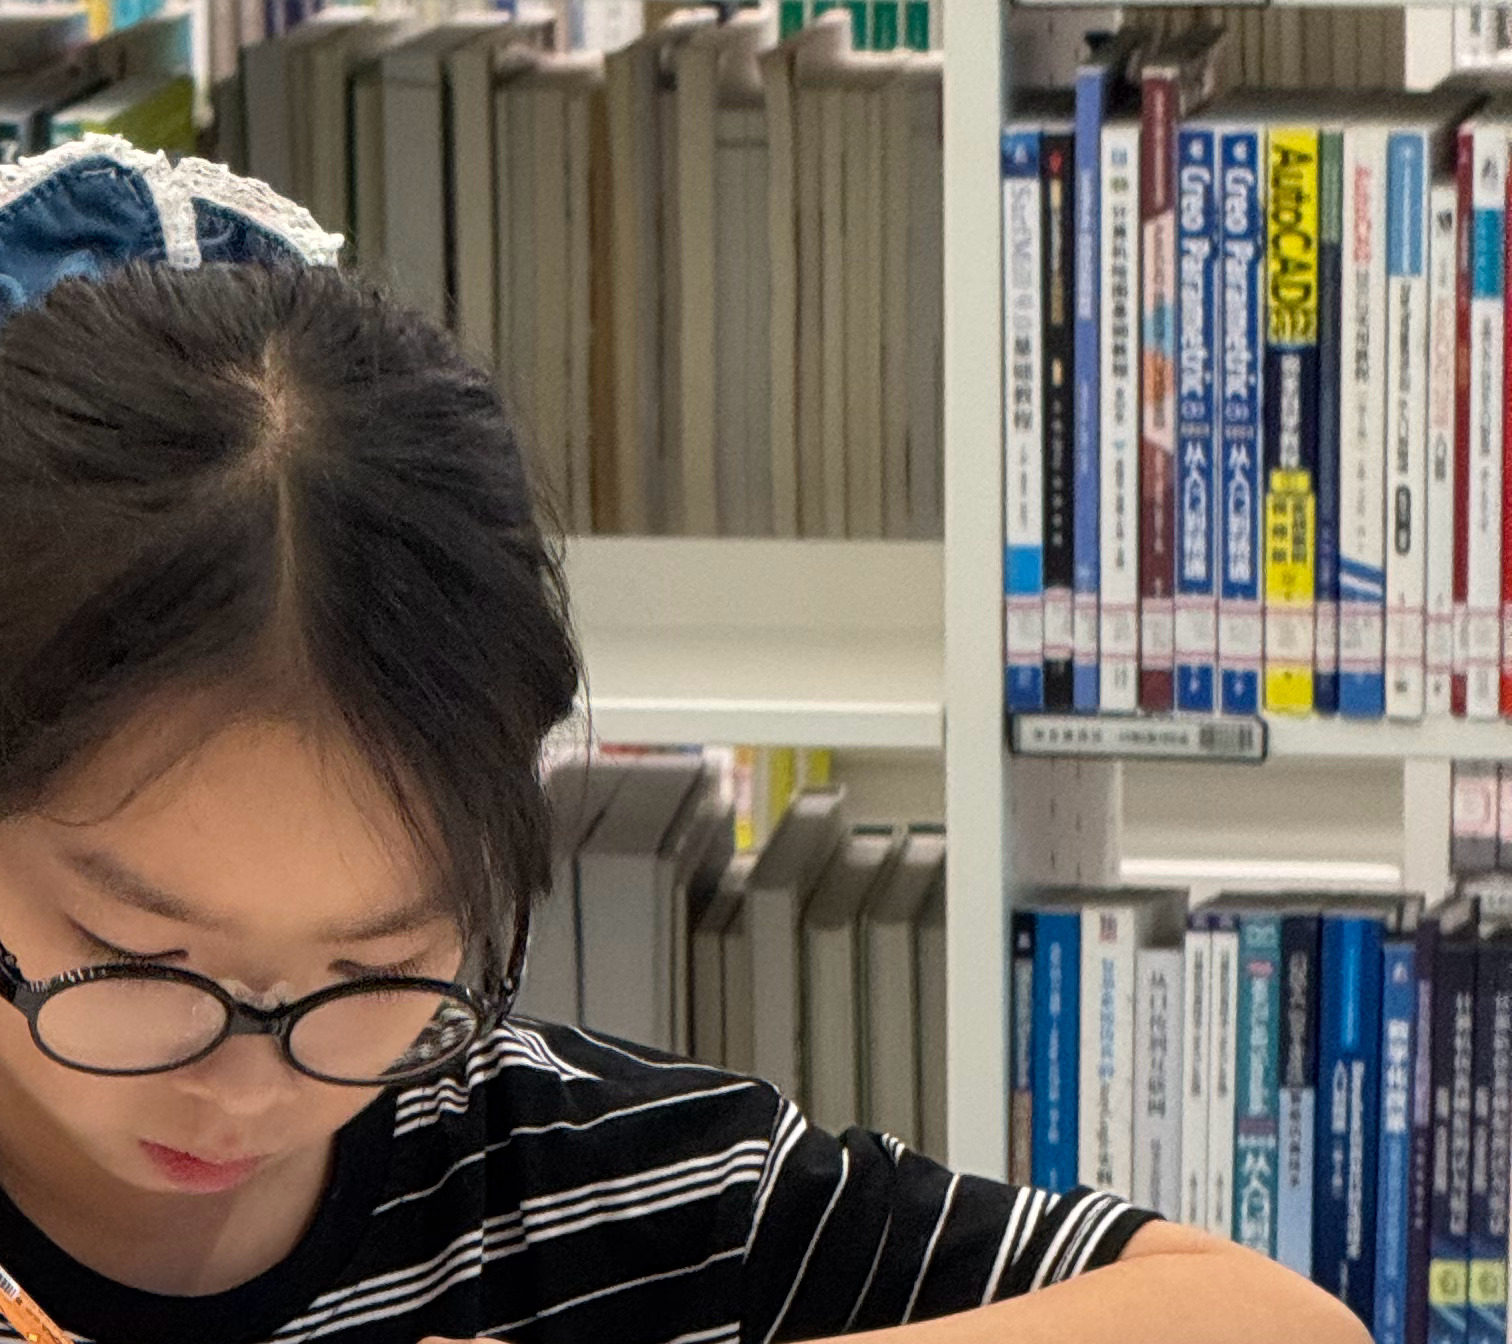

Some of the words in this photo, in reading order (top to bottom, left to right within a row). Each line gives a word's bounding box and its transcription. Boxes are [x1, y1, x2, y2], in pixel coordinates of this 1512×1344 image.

[1181, 166, 1211, 233] Creo
[1224, 166, 1255, 233] Creo
[1271, 144, 1314, 306] AutoCAD
[1181, 237, 1212, 397] Parametric
[1224, 237, 1257, 397] Parametric
